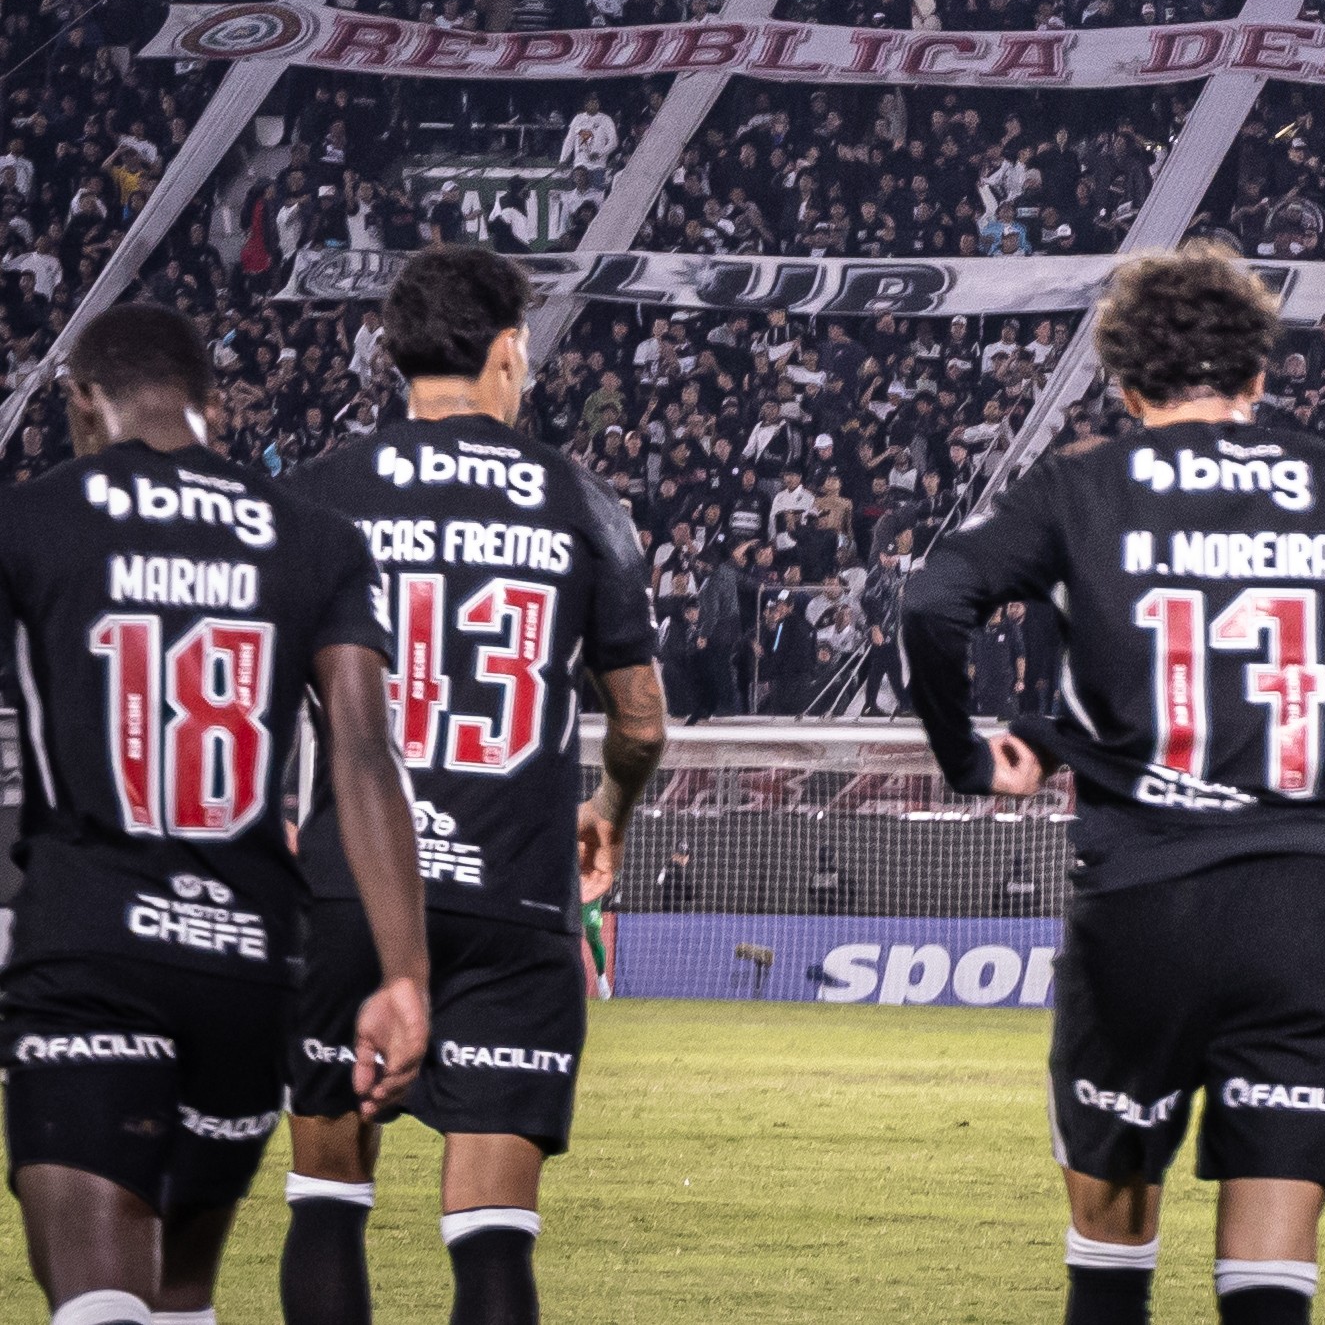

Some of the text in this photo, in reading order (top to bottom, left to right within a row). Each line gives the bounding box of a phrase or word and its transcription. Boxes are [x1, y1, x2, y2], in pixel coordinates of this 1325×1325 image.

[306, 14, 1070, 81] REPUBLICA
[419, 446, 546, 507] bmg
[1178, 448, 1316, 511] bmg
[136, 476, 277, 548] bmg
[444, 521, 573, 573] FREITAS
[109, 555, 259, 609] MARINO
[88, 614, 276, 840] 18
[128, 905, 268, 961] CHEFE
[458, 1045, 573, 1073] FACILITY
